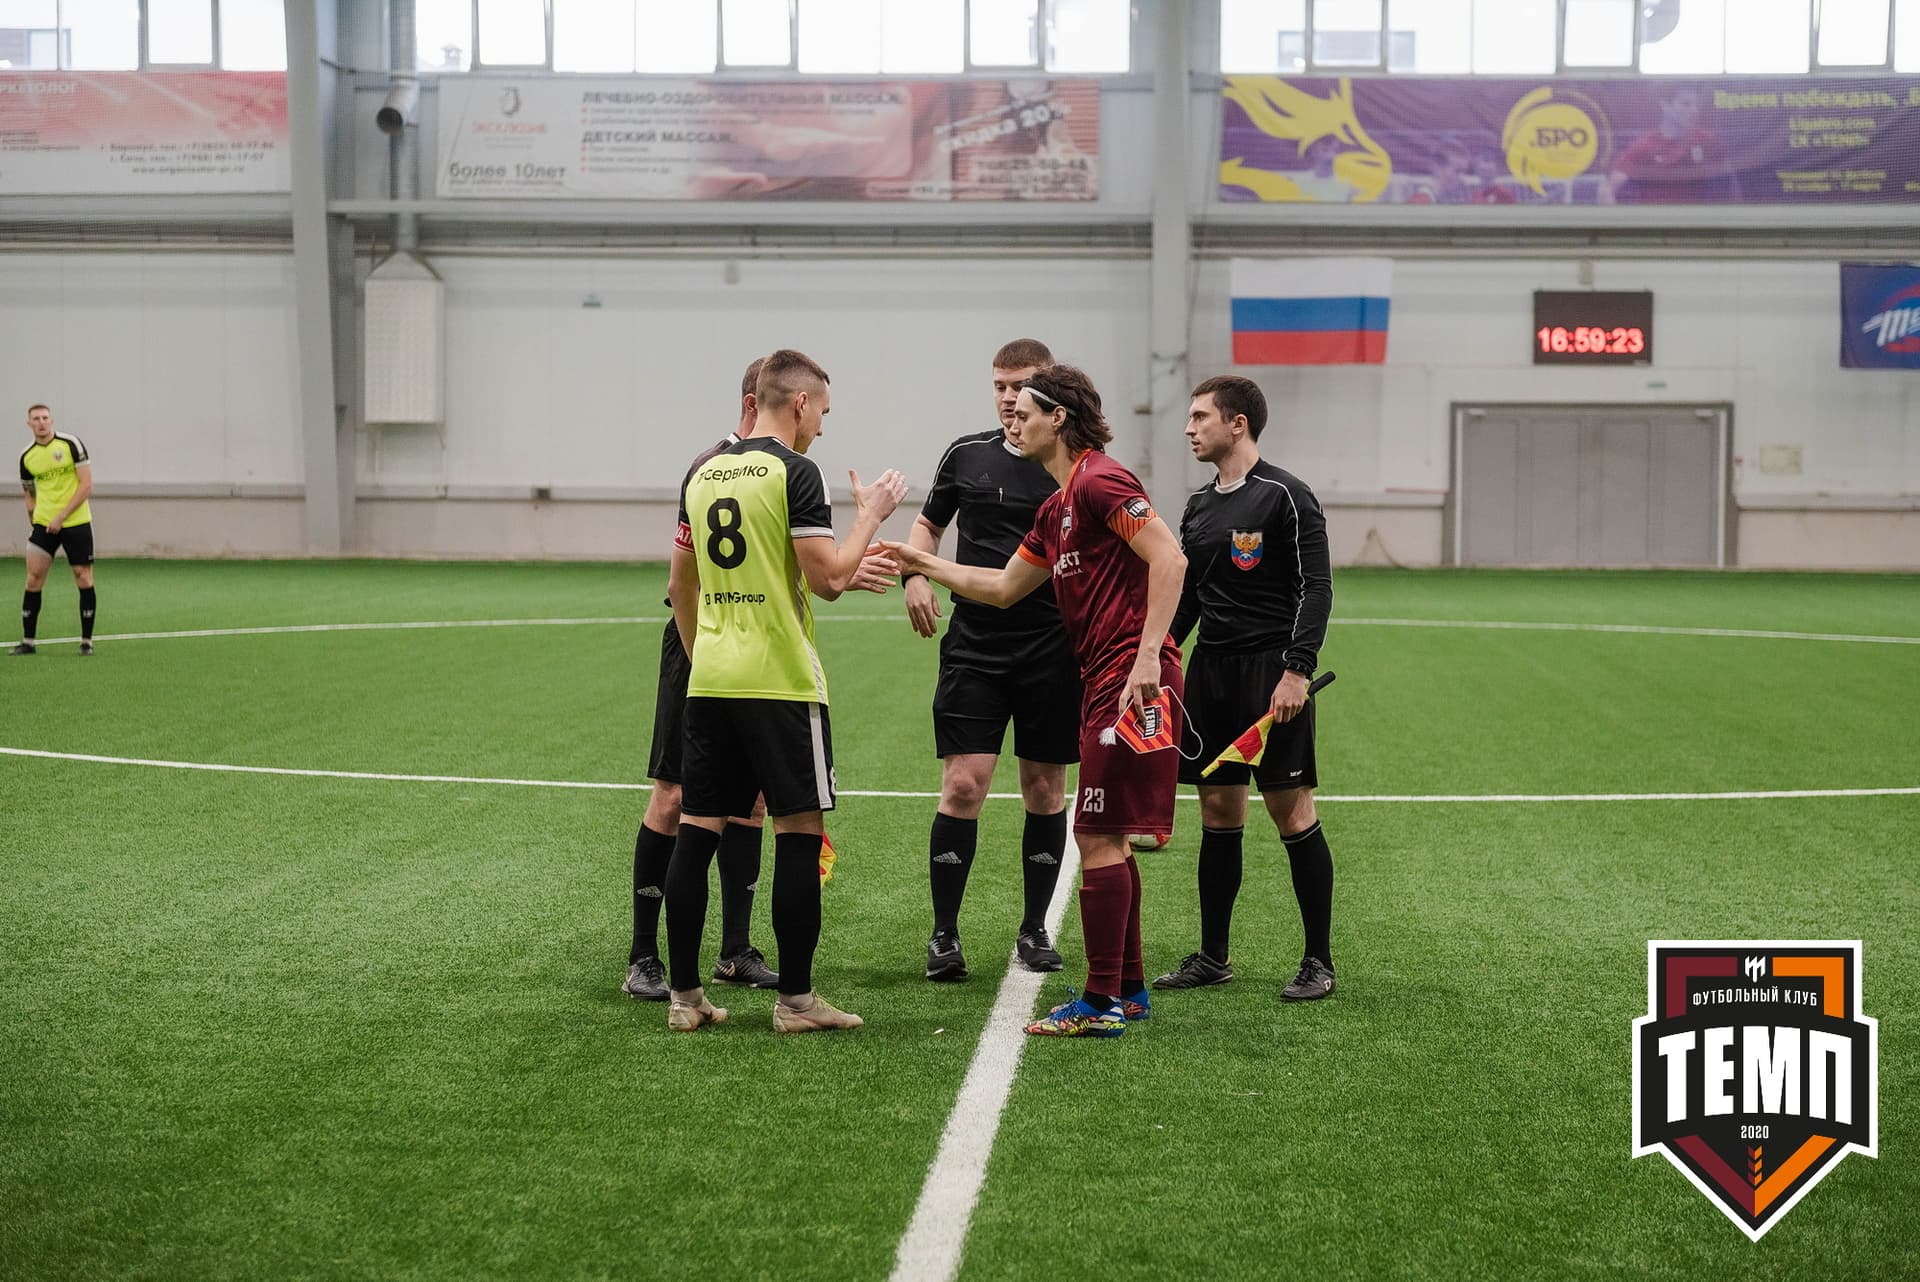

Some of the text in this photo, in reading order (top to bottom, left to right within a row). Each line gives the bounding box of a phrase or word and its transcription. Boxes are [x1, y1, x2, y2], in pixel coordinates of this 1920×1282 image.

[581, 128, 656, 145] ДЕТСКИЙ
[449, 161, 507, 178] более
[1537, 326, 1645, 354] 16:59:23
[706, 497, 747, 569] 8
[1082, 787, 1105, 813] 23
